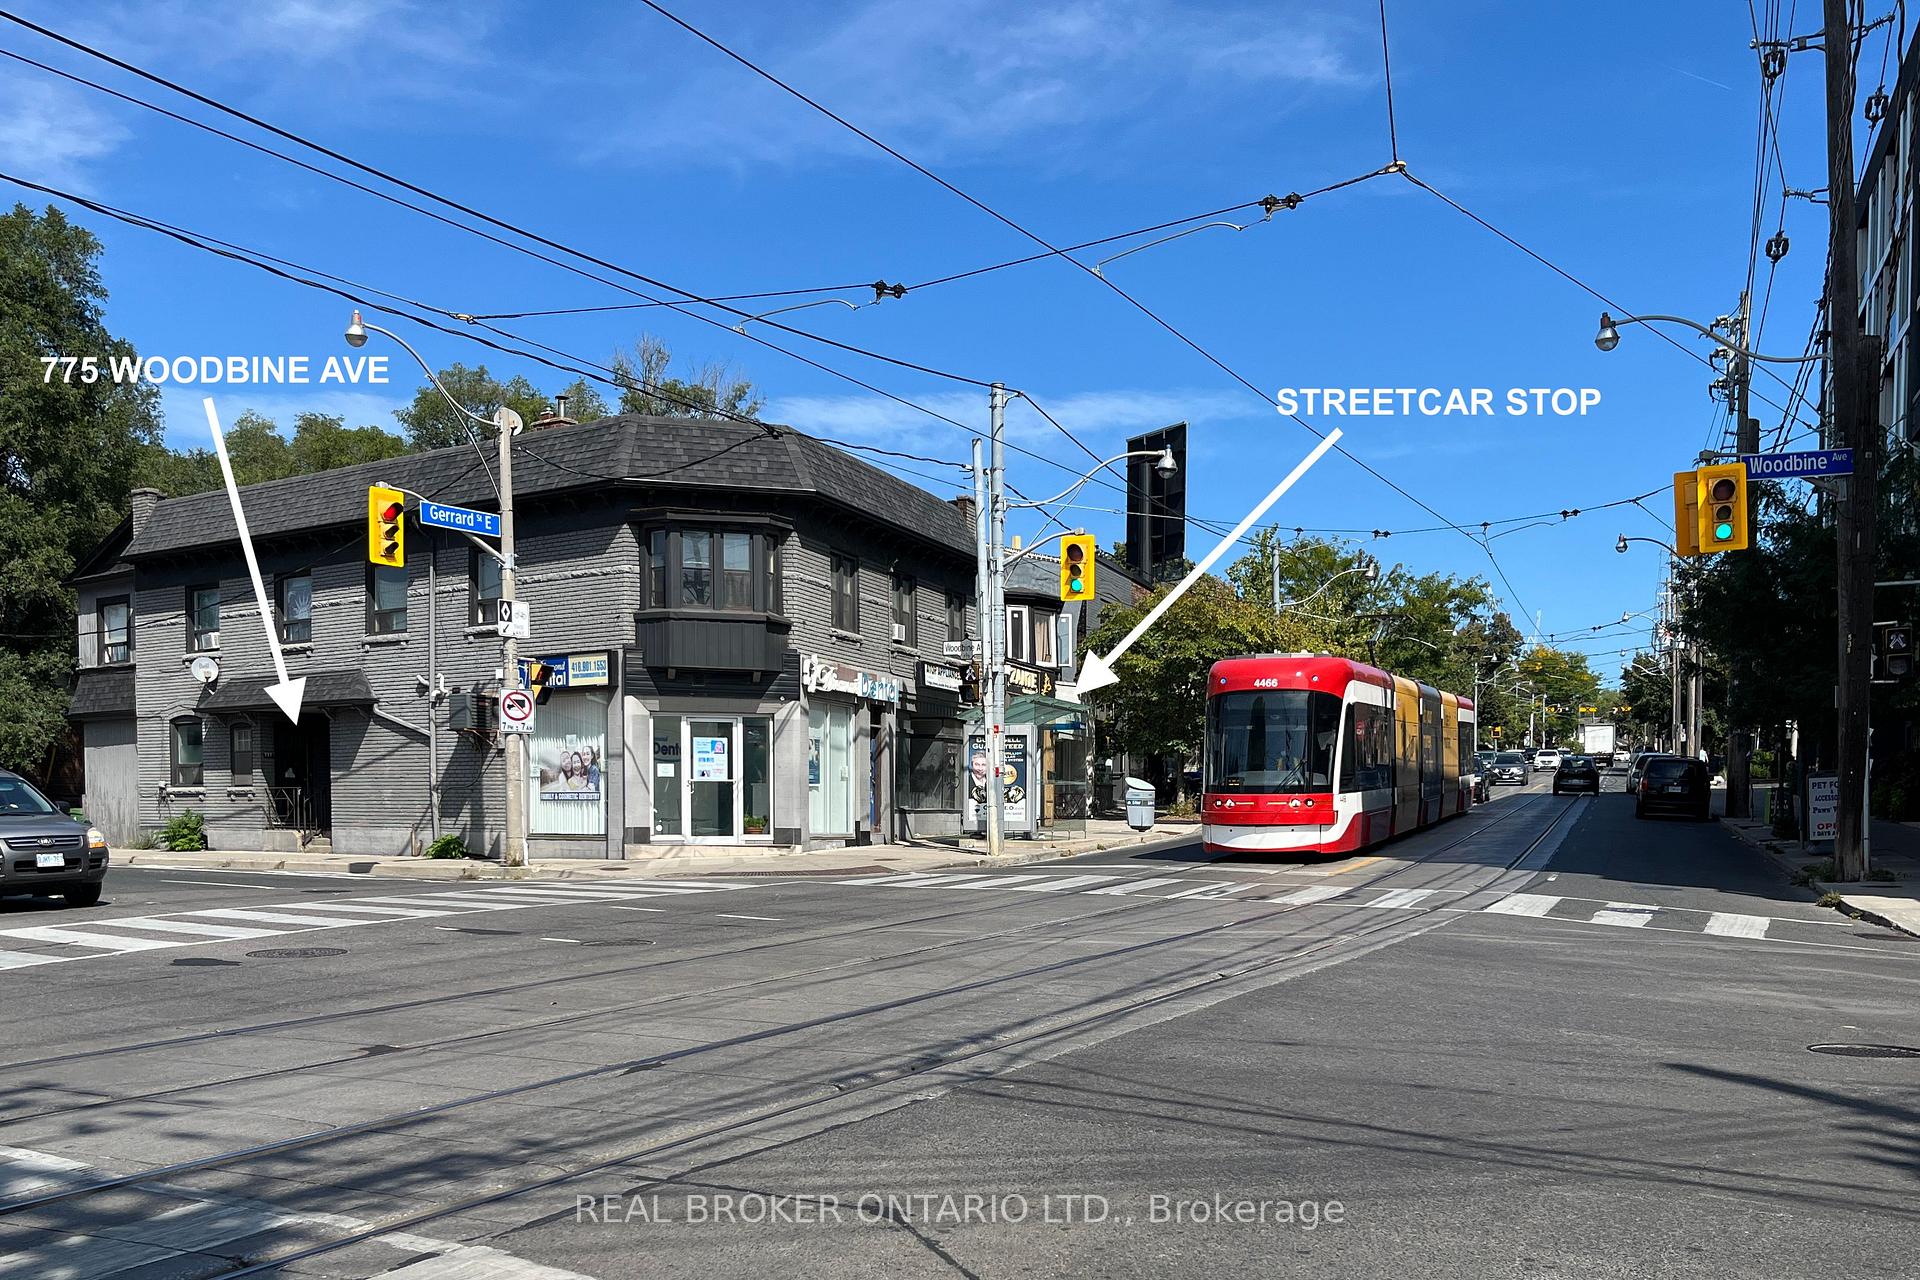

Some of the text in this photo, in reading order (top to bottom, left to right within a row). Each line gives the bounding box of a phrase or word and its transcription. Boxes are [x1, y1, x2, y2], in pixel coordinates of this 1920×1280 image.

[1750, 452, 1848, 474] Woodbine Ave
[429, 505, 492, 530] Gerrard St E
[1254, 678, 1278, 688] 4466
[1830, 781, 1839, 789] FO
